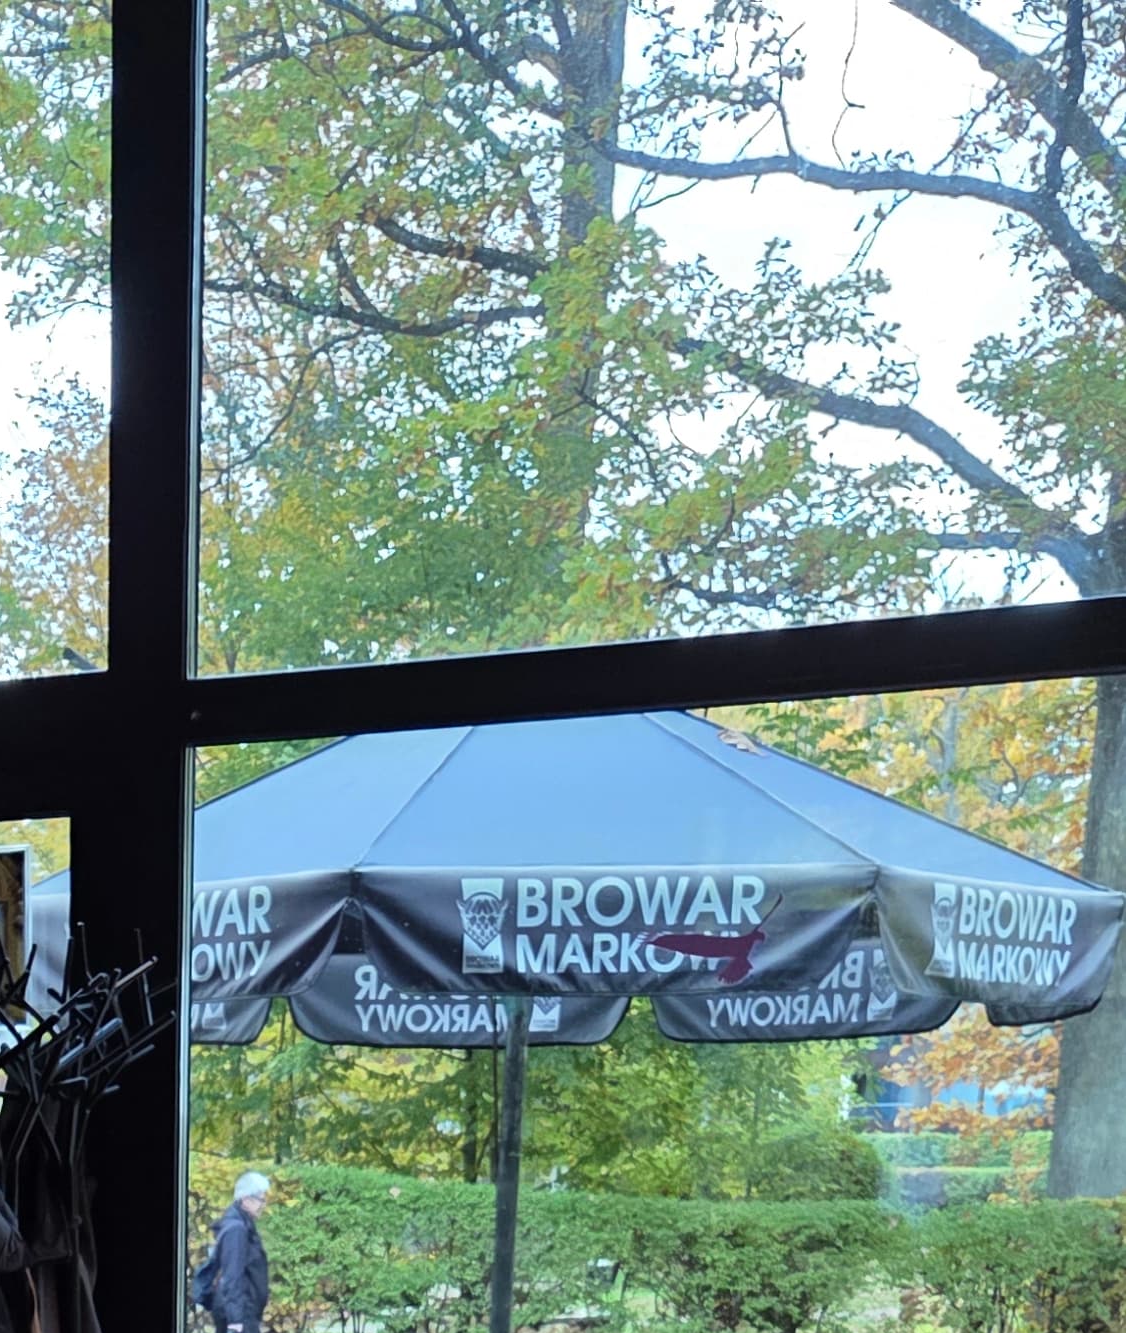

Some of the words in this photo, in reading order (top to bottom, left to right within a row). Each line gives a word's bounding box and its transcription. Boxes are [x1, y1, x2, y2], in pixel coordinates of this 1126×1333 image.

[516, 875, 765, 928] BROWAR
[959, 886, 1077, 945] BROWAR
[516, 932, 740, 973] MARKO
[958, 940, 1072, 986] MARKOWY
